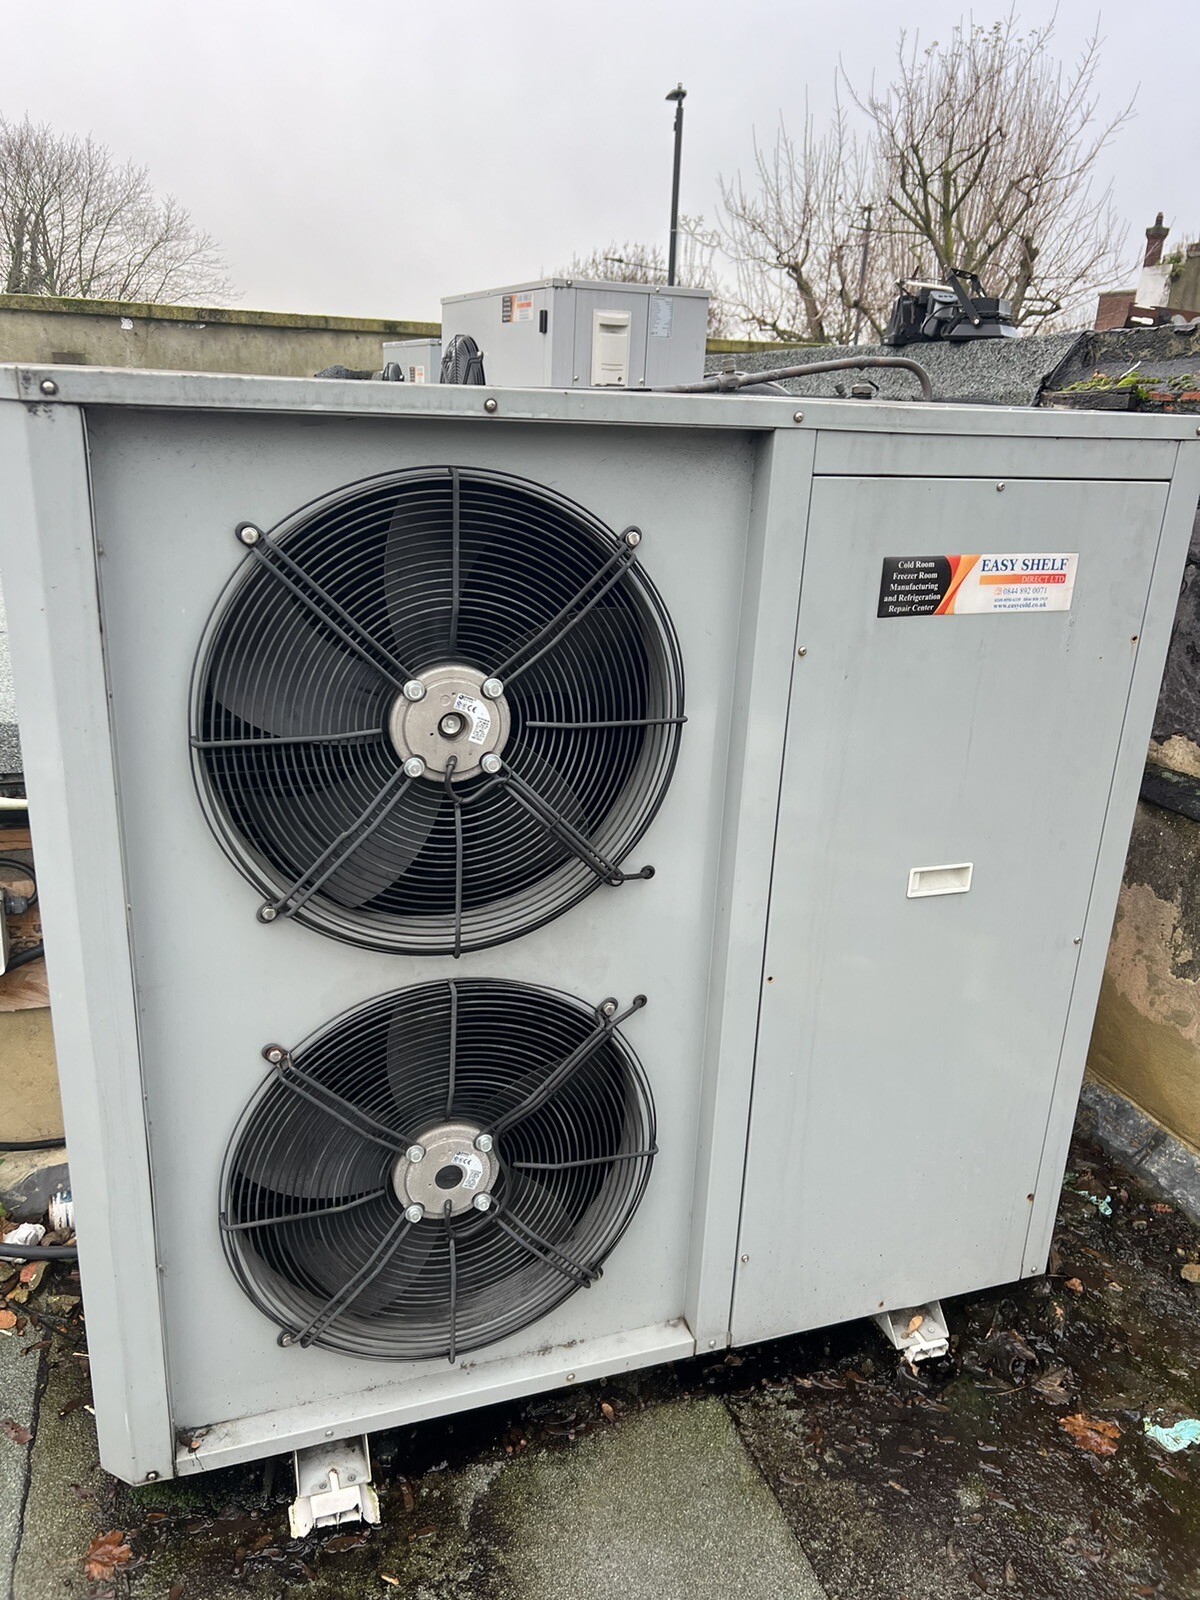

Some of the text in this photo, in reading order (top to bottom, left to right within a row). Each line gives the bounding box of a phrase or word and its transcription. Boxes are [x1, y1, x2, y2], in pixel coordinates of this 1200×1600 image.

[898, 561, 914, 569] Cold
[981, 558, 1069, 572] EASY SHELF
[893, 571, 938, 580] Freezer Room
[1021, 575, 1065, 583] DIRECT LTD
[890, 582, 939, 591] Manufacturing
[1002, 586, 1047, 595] 0844 892 0071
[883, 593, 941, 603] and Refrigeration
[888, 604, 911, 614] Repair
[993, 601, 1047, 609] www.easycold.co.uk
